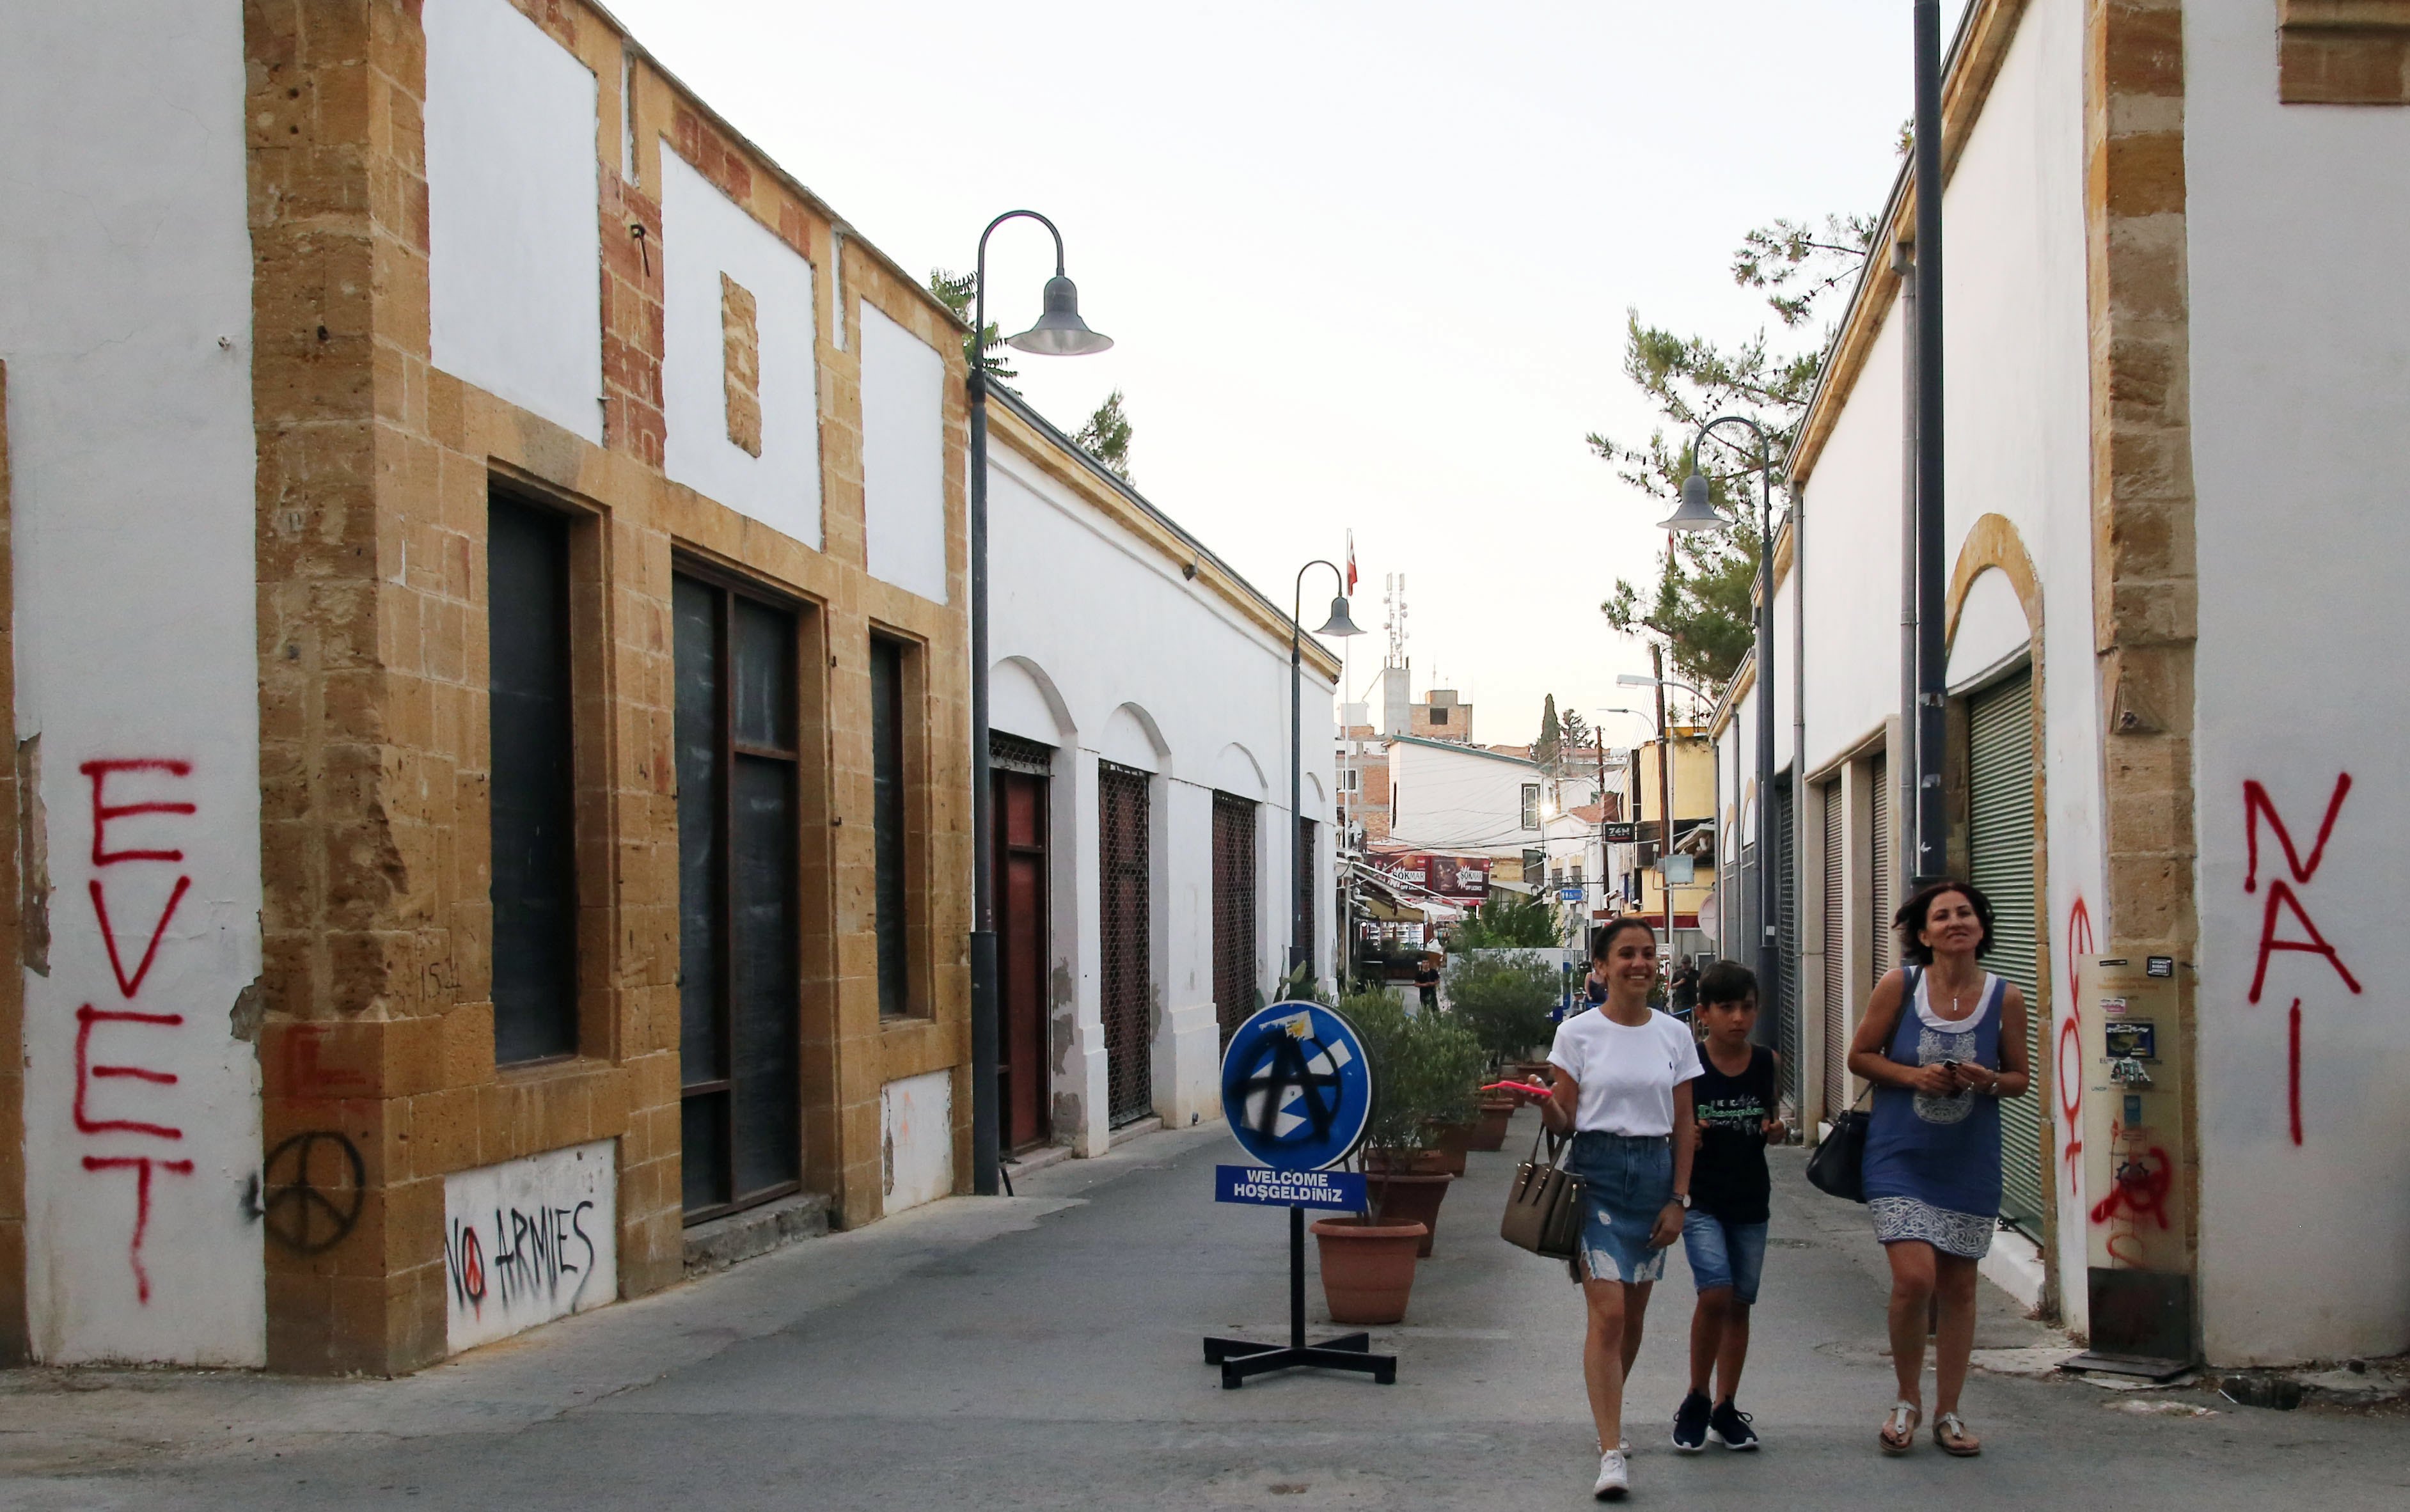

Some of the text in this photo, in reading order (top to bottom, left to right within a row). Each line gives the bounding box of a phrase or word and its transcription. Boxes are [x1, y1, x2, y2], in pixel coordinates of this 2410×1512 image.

[74, 757, 196, 1306] EVET
[1247, 1169, 1328, 1187] WELCOME
[445, 1201, 594, 1314] NO ARMIES
